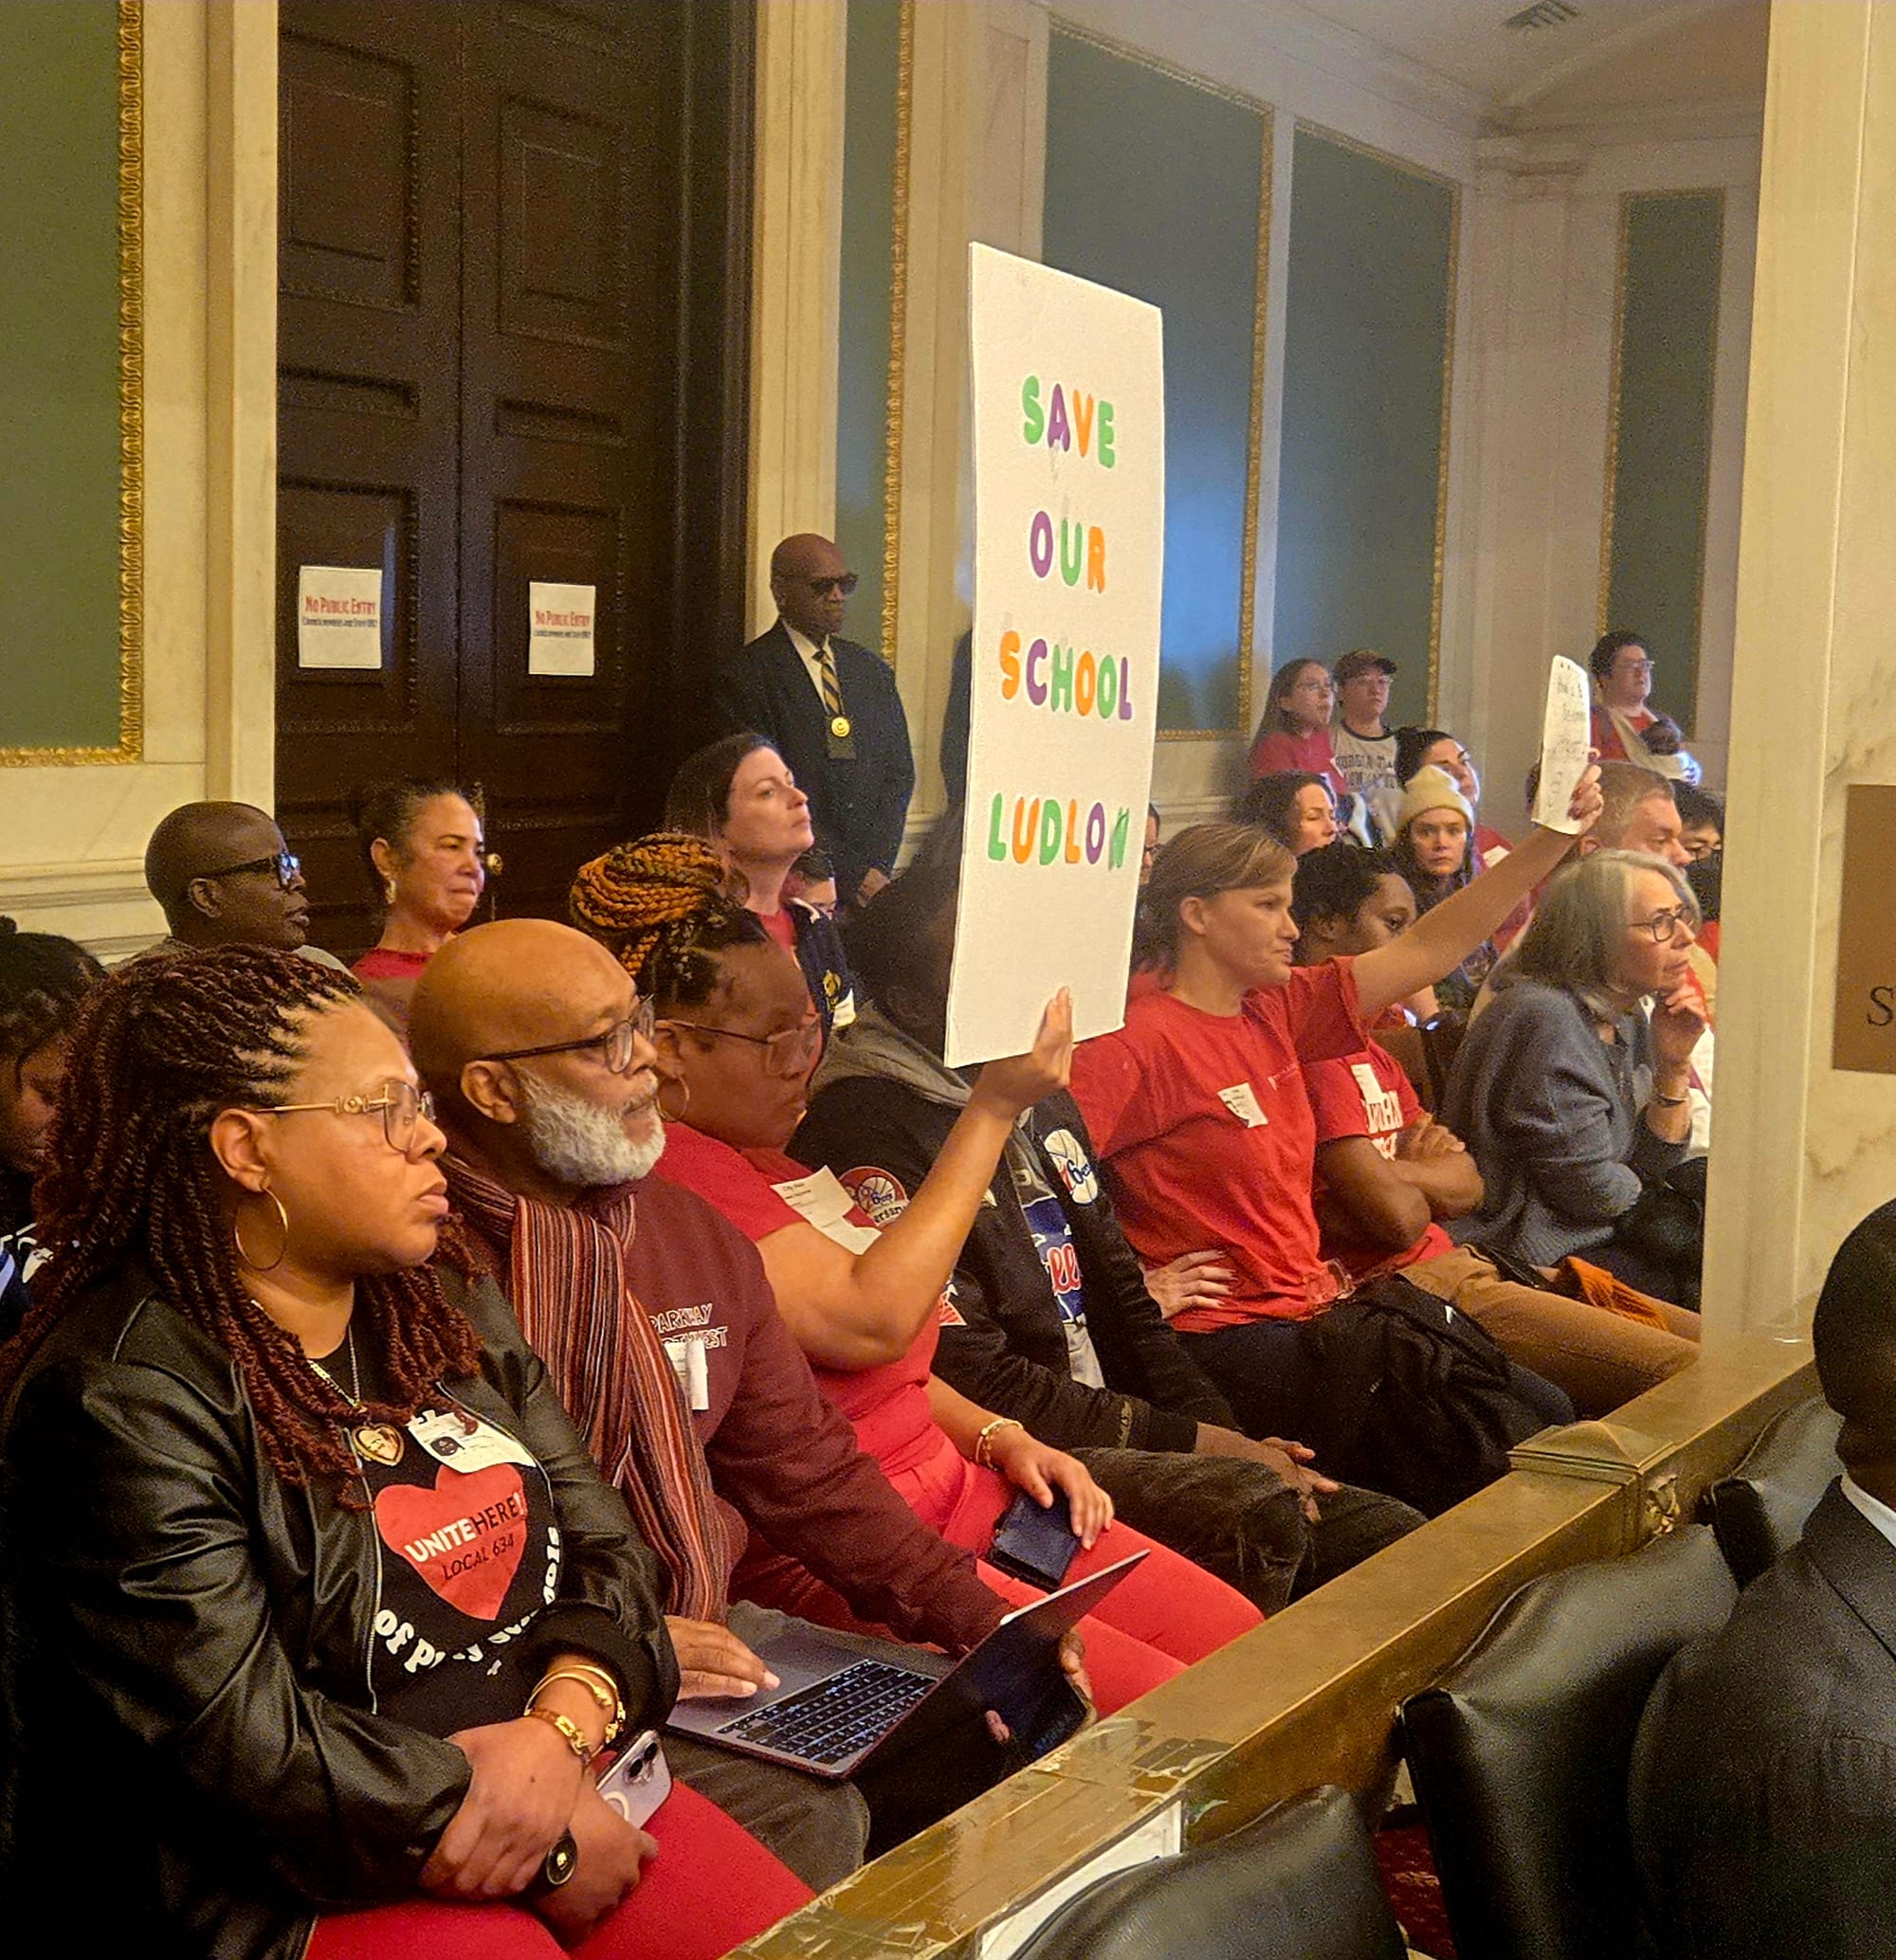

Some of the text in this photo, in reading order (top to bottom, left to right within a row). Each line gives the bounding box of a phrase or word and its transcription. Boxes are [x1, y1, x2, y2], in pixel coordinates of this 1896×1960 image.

[1021, 374, 1116, 469] SAVE
[1030, 509, 1106, 594] OUR
[999, 630, 1133, 721] SCHOOL
[442, 1534, 515, 1581] LOCAL 634
